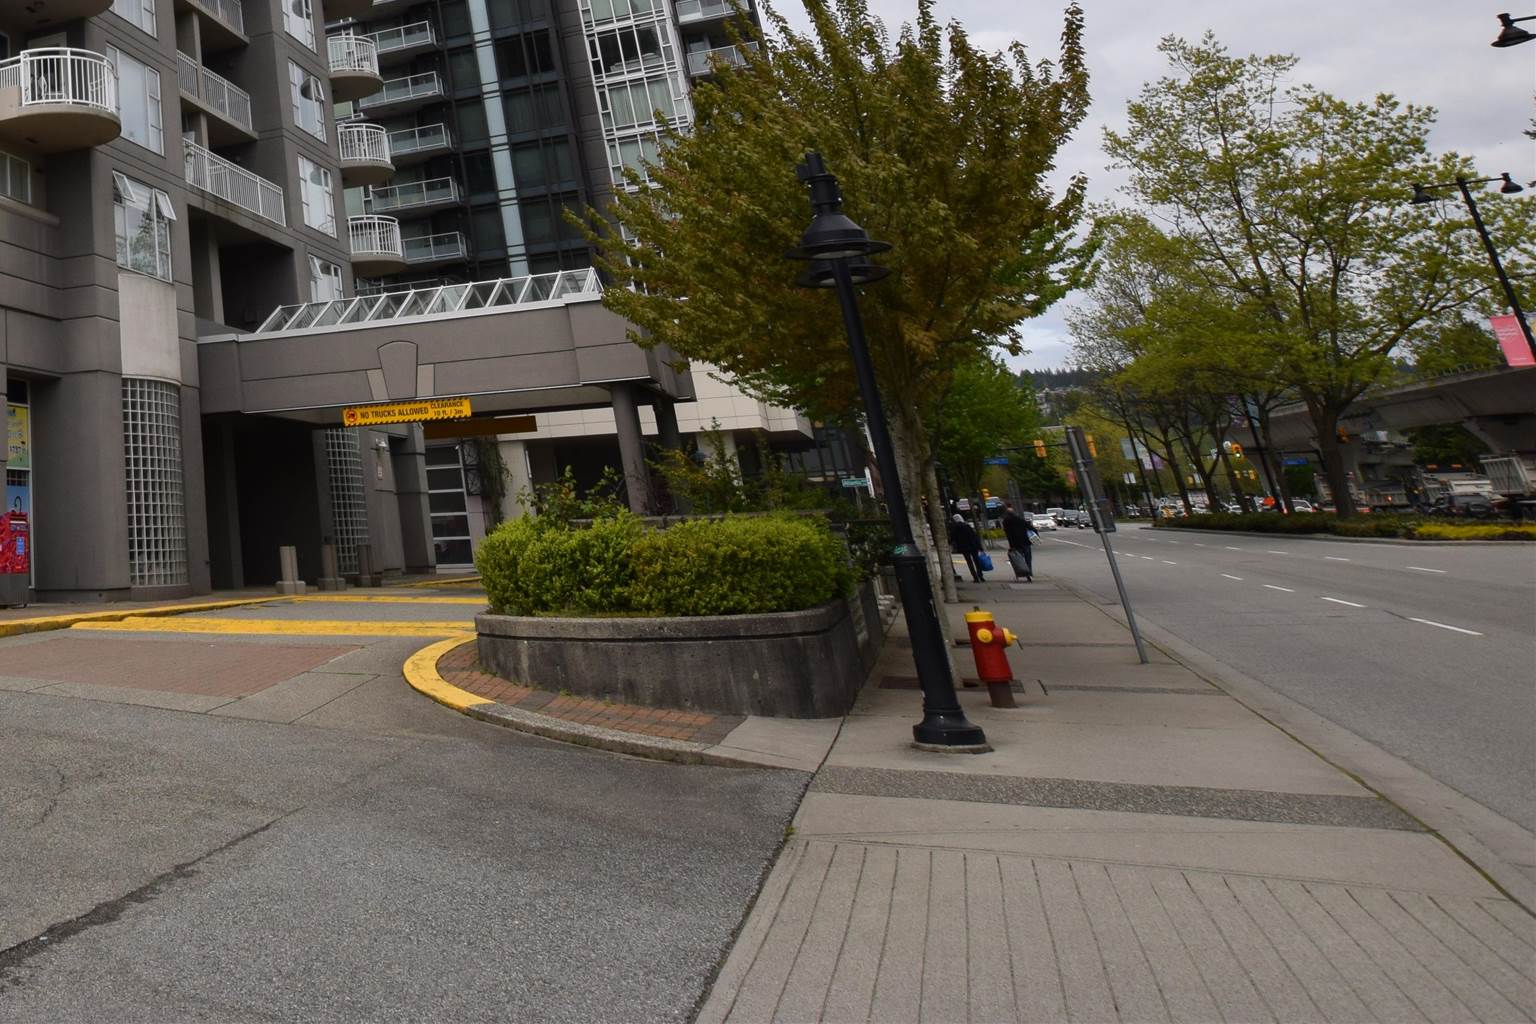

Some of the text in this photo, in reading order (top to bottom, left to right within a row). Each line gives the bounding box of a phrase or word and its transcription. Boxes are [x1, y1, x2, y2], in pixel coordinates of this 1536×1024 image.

[430, 401, 464, 409] CLEARANCE
[371, 408, 396, 418] TRUCKS
[398, 406, 429, 416] ALLOWED
